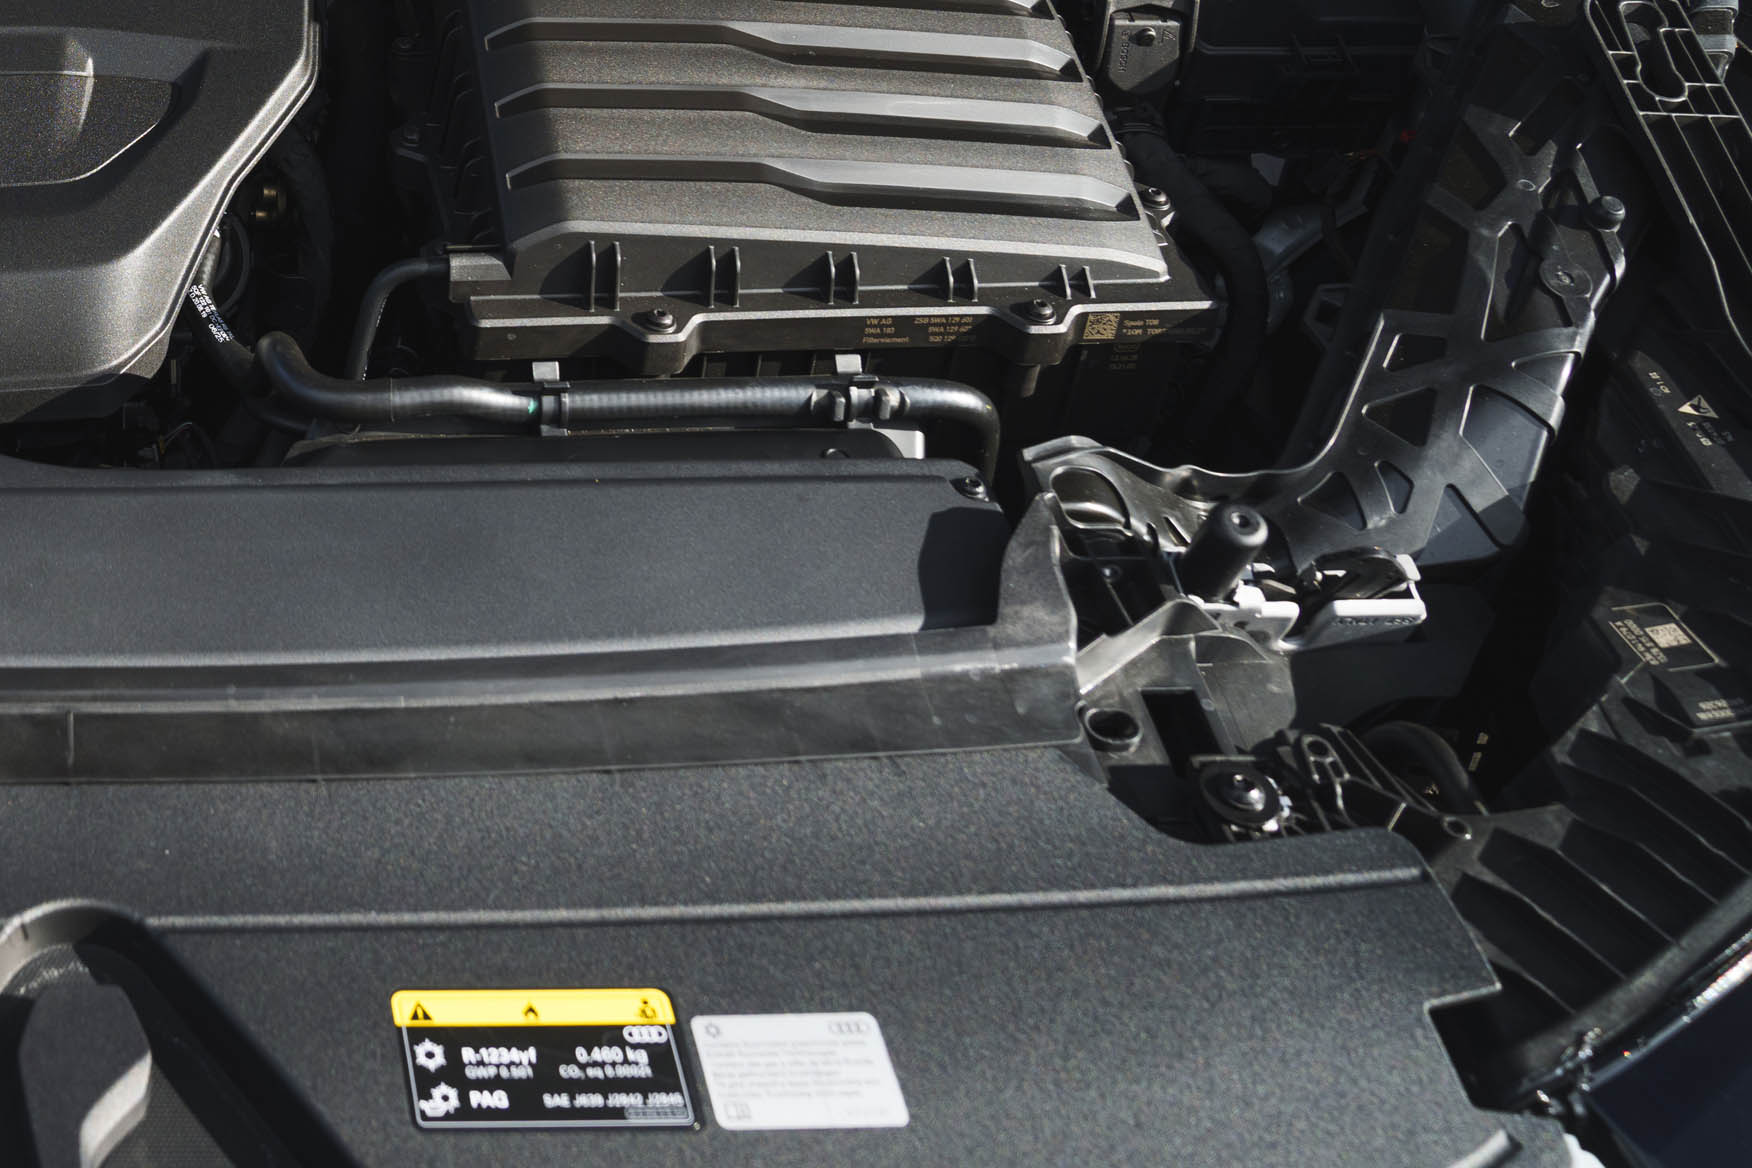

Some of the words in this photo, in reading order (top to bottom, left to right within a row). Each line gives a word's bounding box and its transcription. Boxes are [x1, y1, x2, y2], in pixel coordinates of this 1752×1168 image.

[460, 1046, 538, 1065] R-1234yf
[625, 1046, 649, 1066] kg
[464, 1065, 498, 1080] GWP
[468, 1090, 510, 1109] PAG
[542, 1093, 571, 1109] SAE
